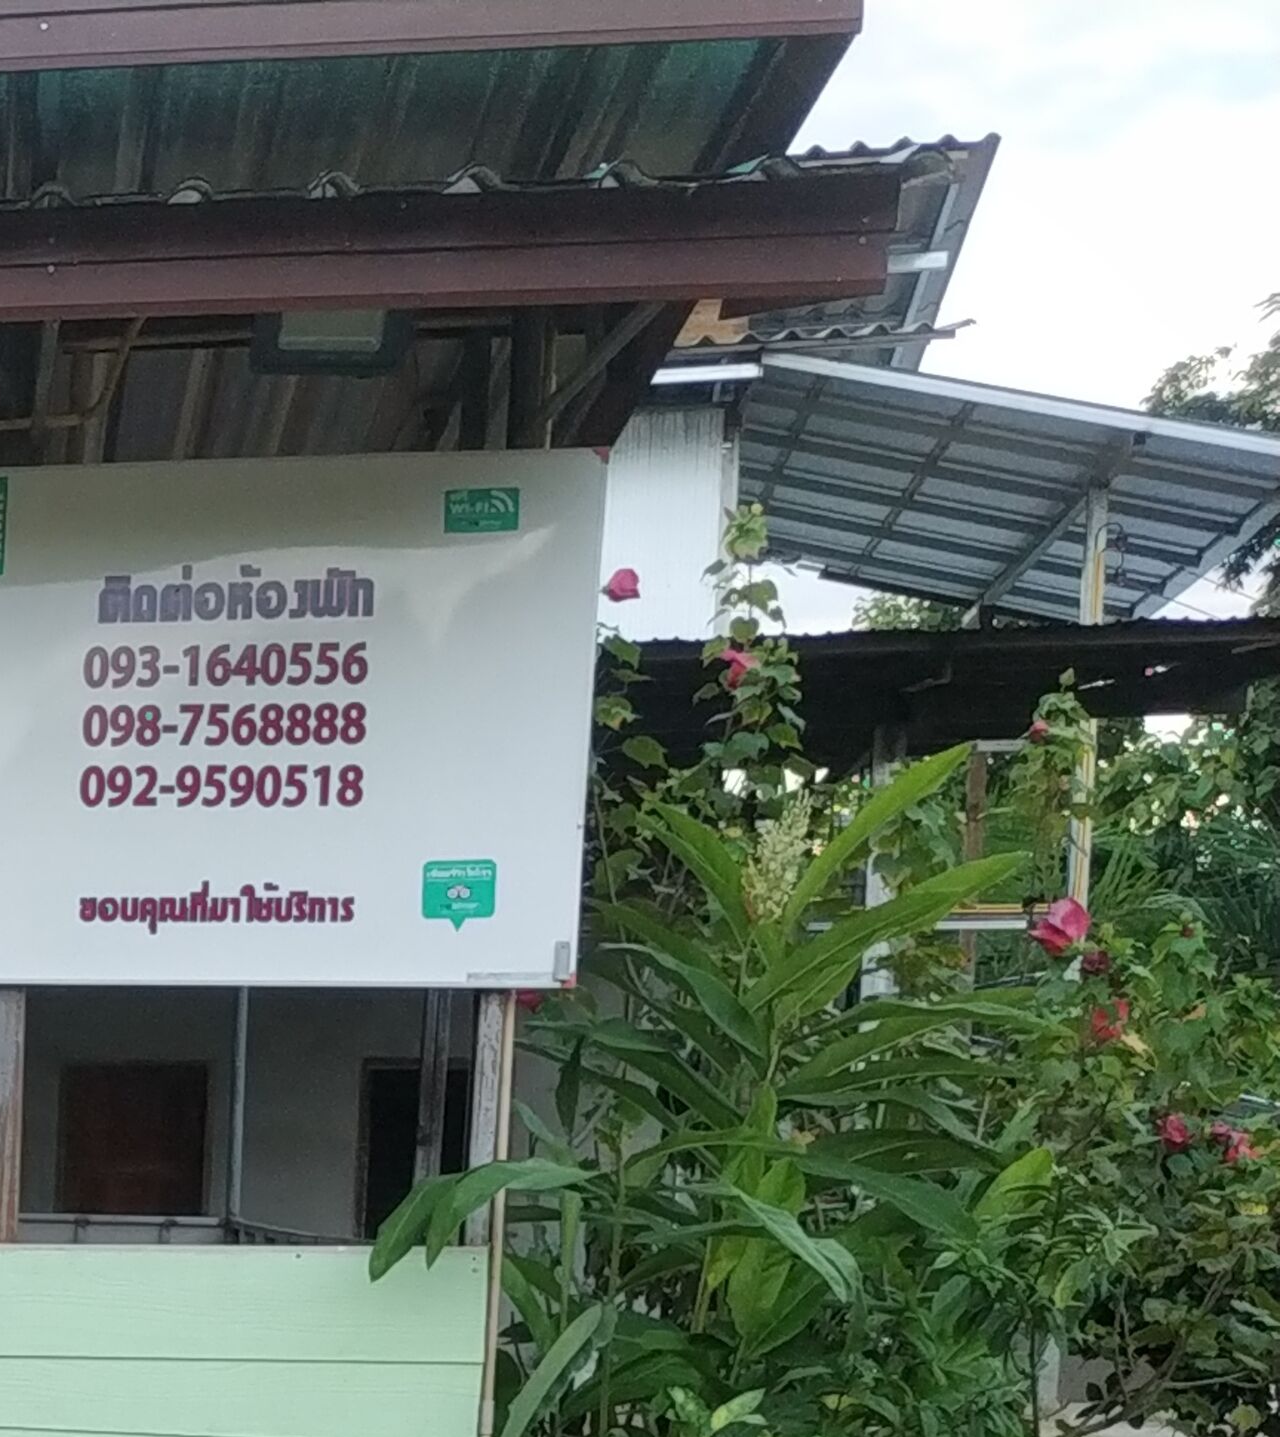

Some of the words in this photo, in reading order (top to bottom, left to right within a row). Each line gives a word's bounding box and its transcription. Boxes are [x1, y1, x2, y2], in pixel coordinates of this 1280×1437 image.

[97, 564, 376, 624] ติดต่อห้องพัก
[83, 641, 369, 688] 093-1640556
[82, 701, 368, 747] 098-7568888
[79, 763, 365, 808] 092-9590518
